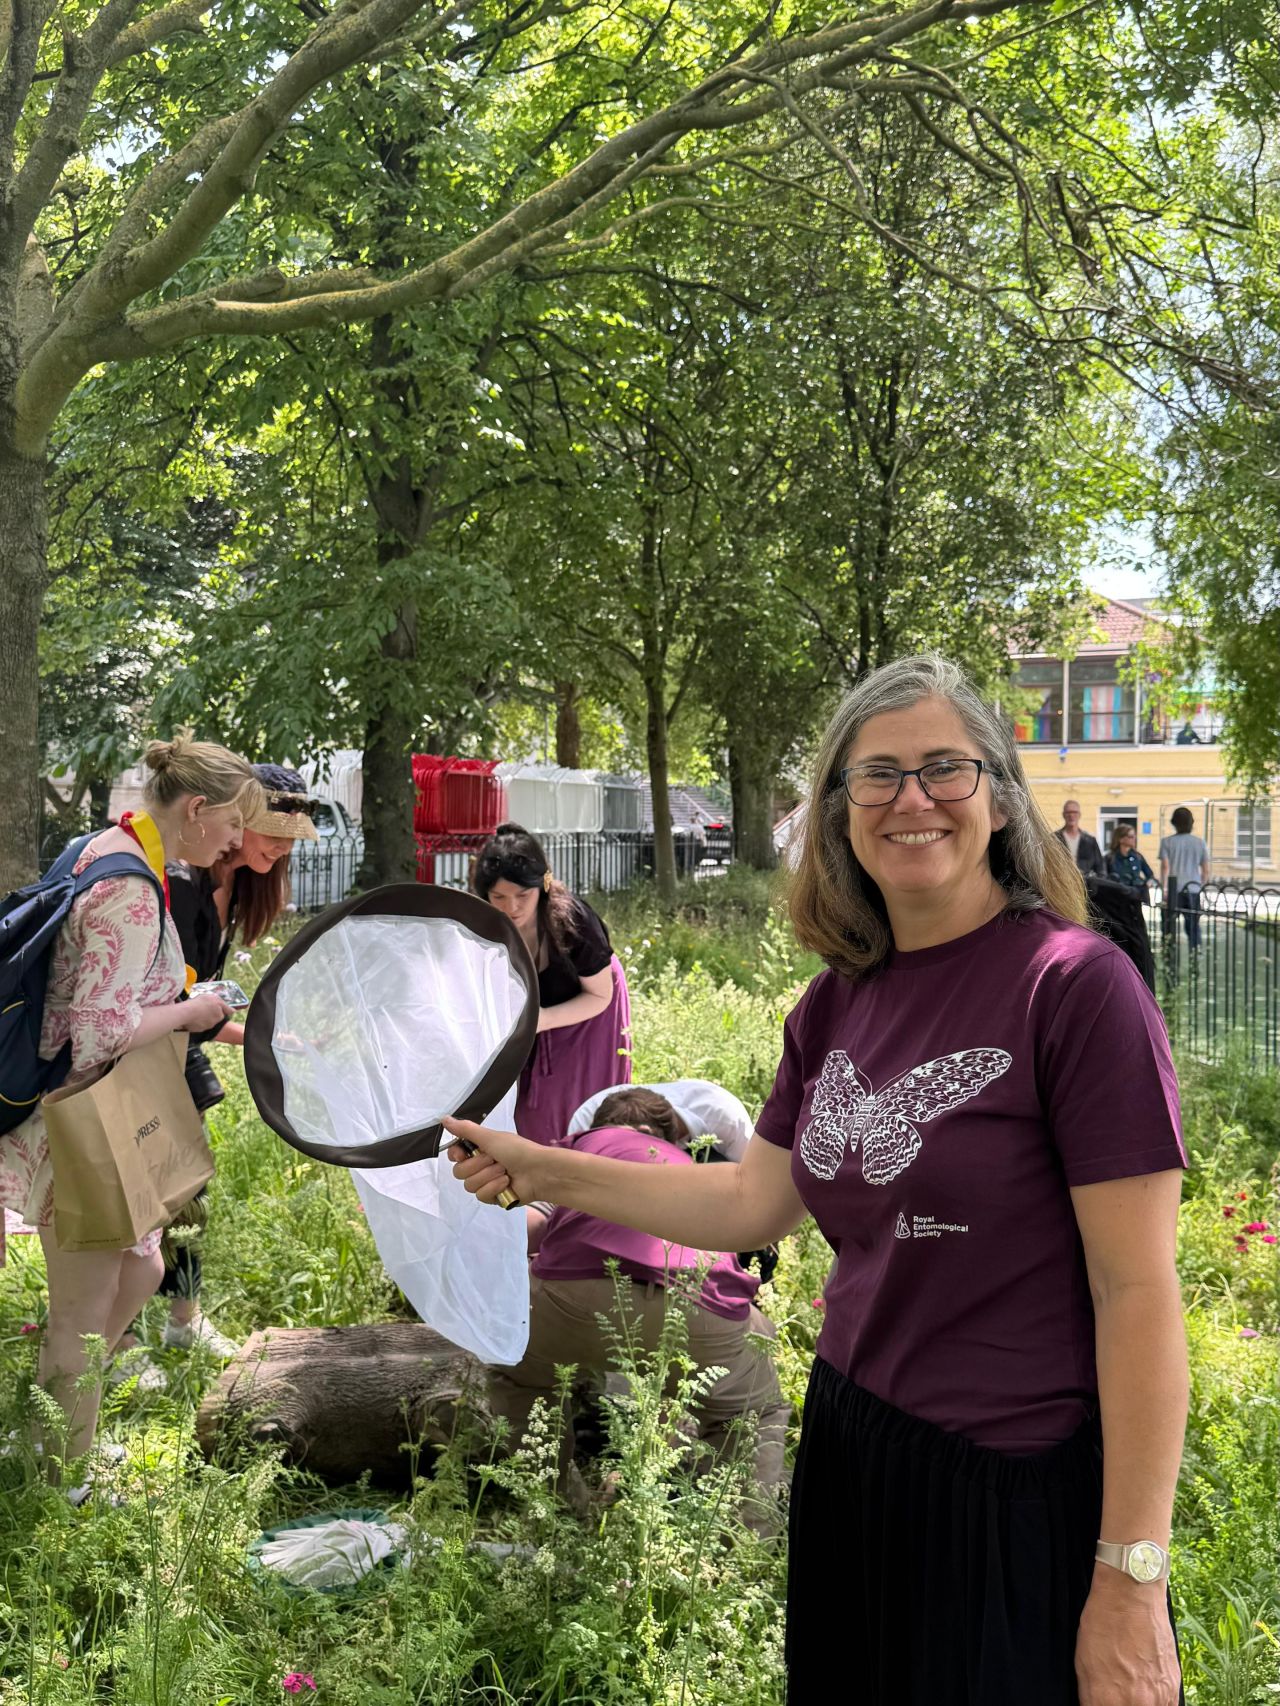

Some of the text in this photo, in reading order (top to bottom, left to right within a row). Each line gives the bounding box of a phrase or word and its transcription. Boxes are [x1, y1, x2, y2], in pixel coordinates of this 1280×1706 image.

[913, 1215, 935, 1223] Royal
[913, 1223, 969, 1232] Entomological
[913, 1230, 942, 1238] Society
